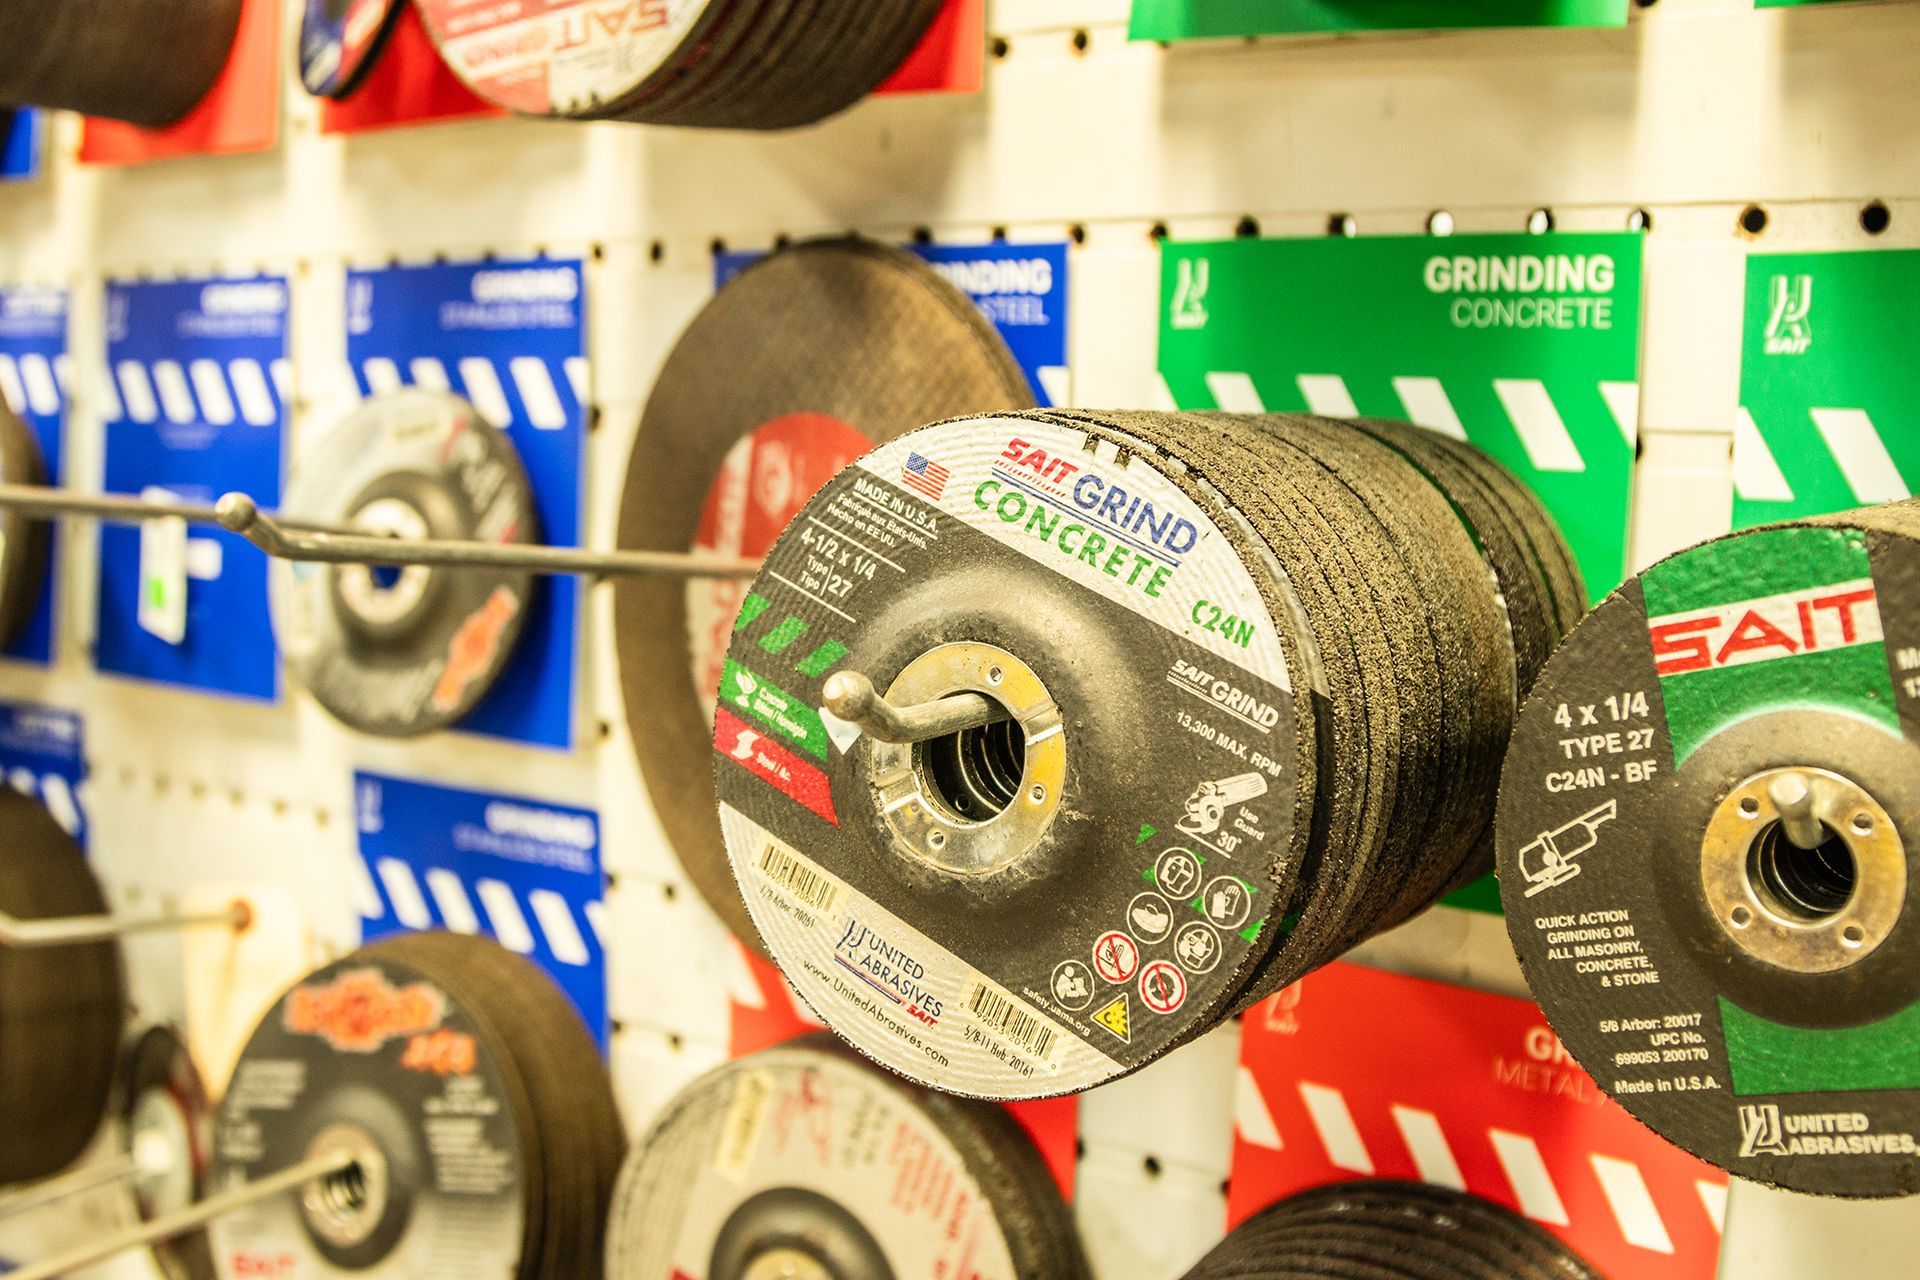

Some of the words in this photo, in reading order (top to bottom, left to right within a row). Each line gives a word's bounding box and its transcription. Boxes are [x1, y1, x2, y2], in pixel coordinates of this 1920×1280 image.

[1424, 254, 1616, 292] GRINDING
[1450, 297, 1614, 329] CONCRETE
[854, 477, 891, 507] MADE
[891, 496, 905, 513] IN
[905, 505, 939, 534] U.S.A.
[1001, 437, 1079, 485] SAIT
[1073, 474, 1198, 554] GRIND
[827, 503, 854, 525] Hecho
[854, 520, 867, 532] en
[871, 512, 887, 528] aux
[974, 480, 1173, 598] CONCRETE
[800, 527, 839, 560] 4-1/2
[838, 550, 851, 567] x
[853, 555, 877, 581] 1/4
[806, 554, 829, 576] Type
[800, 570, 820, 591] Tipo
[828, 574, 853, 598] 27
[1191, 599, 1256, 649] C24N
[1649, 588, 1876, 676] SAIT
[1171, 659, 1216, 687] SAIT
[1210, 681, 1280, 728] GRIND
[1554, 703, 1572, 728] 4
[1580, 705, 1599, 725] x
[1607, 690, 1650, 722] 1/4
[1176, 711, 1216, 741] 13,300
[1215, 733, 1248, 761] MAX.
[1250, 752, 1282, 778] RPM
[1560, 732, 1624, 760] TYPE
[1627, 728, 1655, 752] 27
[1545, 765, 1606, 793] C24N
[1626, 760, 1658, 783] BF
[1234, 818, 1266, 841] Guard
[1239, 806, 1259, 824] Use
[1534, 913, 1577, 931] QUICK
[1578, 909, 1630, 927] ACTION
[1547, 928, 1611, 945] GRINDING
[1613, 924, 1636, 939] ON
[869, 933, 925, 980] UNITED
[1547, 946, 1572, 960] ALL
[1573, 940, 1644, 959] MASONRY,
[1575, 956, 1655, 975] CONCRETE,
[1600, 975, 1612, 988] &
[1613, 971, 1661, 987] STONE
[859, 954, 944, 1017] ABRASIVES
[802, 958, 949, 1068] www.UnitedAbrasives.com
[1023, 986, 1092, 1037] safety.uama.org
[1600, 1018, 1620, 1033] 5/8
[1620, 1016, 1663, 1033] Arbor:
[1664, 1013, 1703, 1029] 20017
[1650, 1032, 1681, 1047] UPC
[1682, 1030, 1707, 1045] No.
[1009, 1055, 1035, 1079] 20161
[1615, 1050, 1661, 1066] 699053
[1662, 1047, 1709, 1063] 200170
[1614, 1078, 1656, 1094] Made
[1657, 1078, 1672, 1092] in
[1676, 1075, 1722, 1092] U.S.A.
[1784, 1112, 1870, 1134] UNITED
